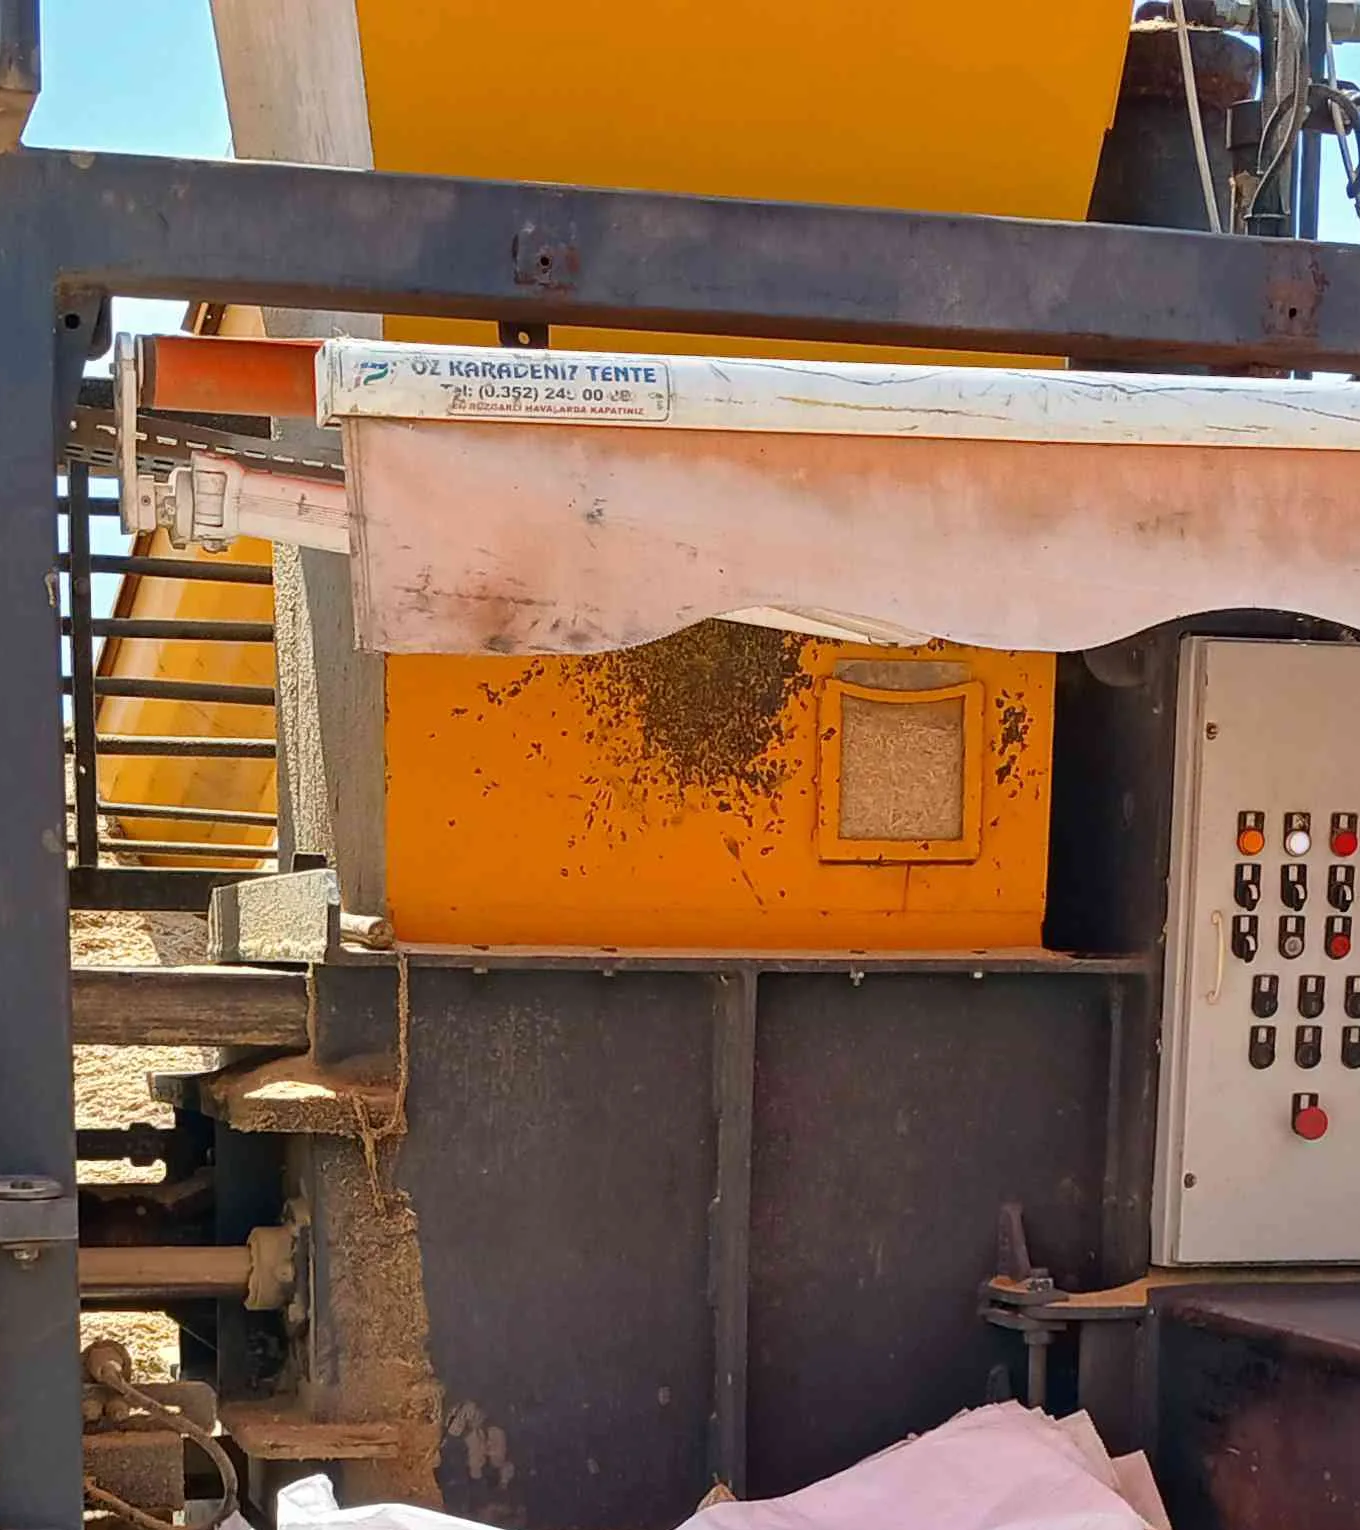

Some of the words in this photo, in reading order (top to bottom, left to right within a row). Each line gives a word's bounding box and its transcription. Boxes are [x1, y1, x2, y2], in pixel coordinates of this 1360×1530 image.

[586, 365, 657, 383] TENTE
[478, 384, 539, 402] (0.352)
[582, 387, 604, 402] 00
